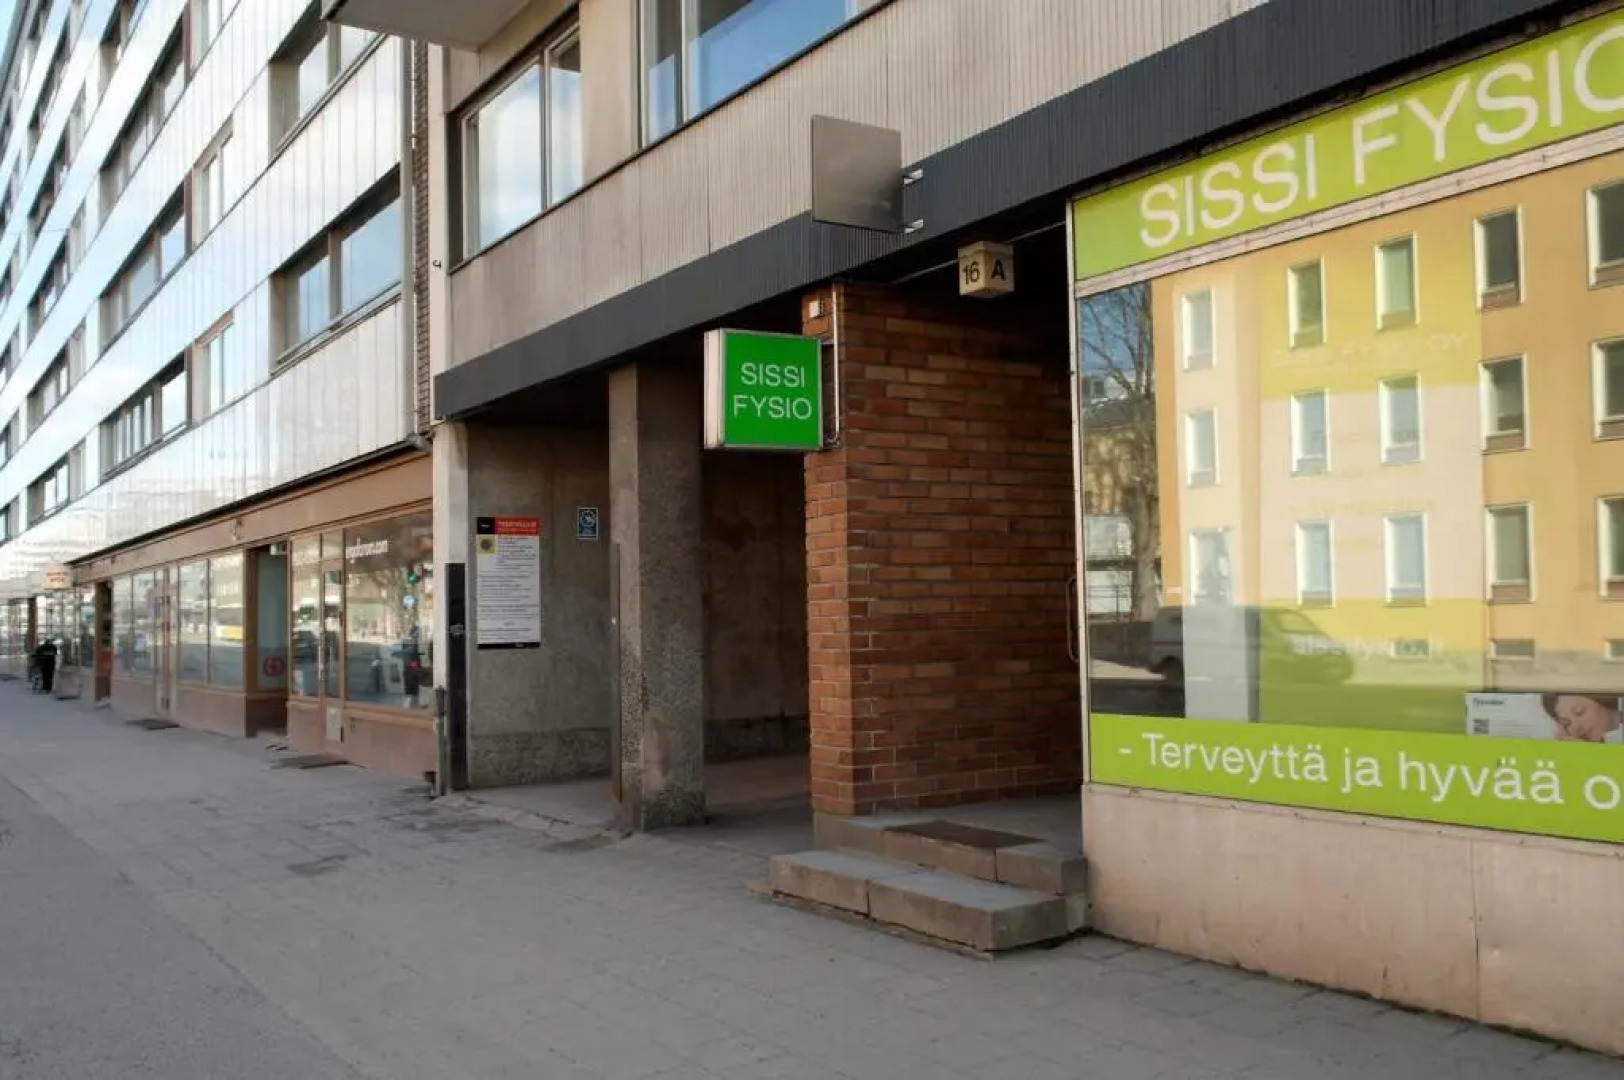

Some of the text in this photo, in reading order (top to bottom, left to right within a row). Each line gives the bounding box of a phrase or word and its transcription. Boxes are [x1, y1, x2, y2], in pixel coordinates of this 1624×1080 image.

[1140, 134, 1316, 248] SISSI
[962, 258, 1006, 285] 16 A
[741, 362, 805, 388] SISSI
[733, 395, 812, 420] FYSIO
[1142, 733, 1328, 783] Terveyttä
[1341, 748, 1383, 793] ja
[1399, 751, 1565, 803] hyvää
